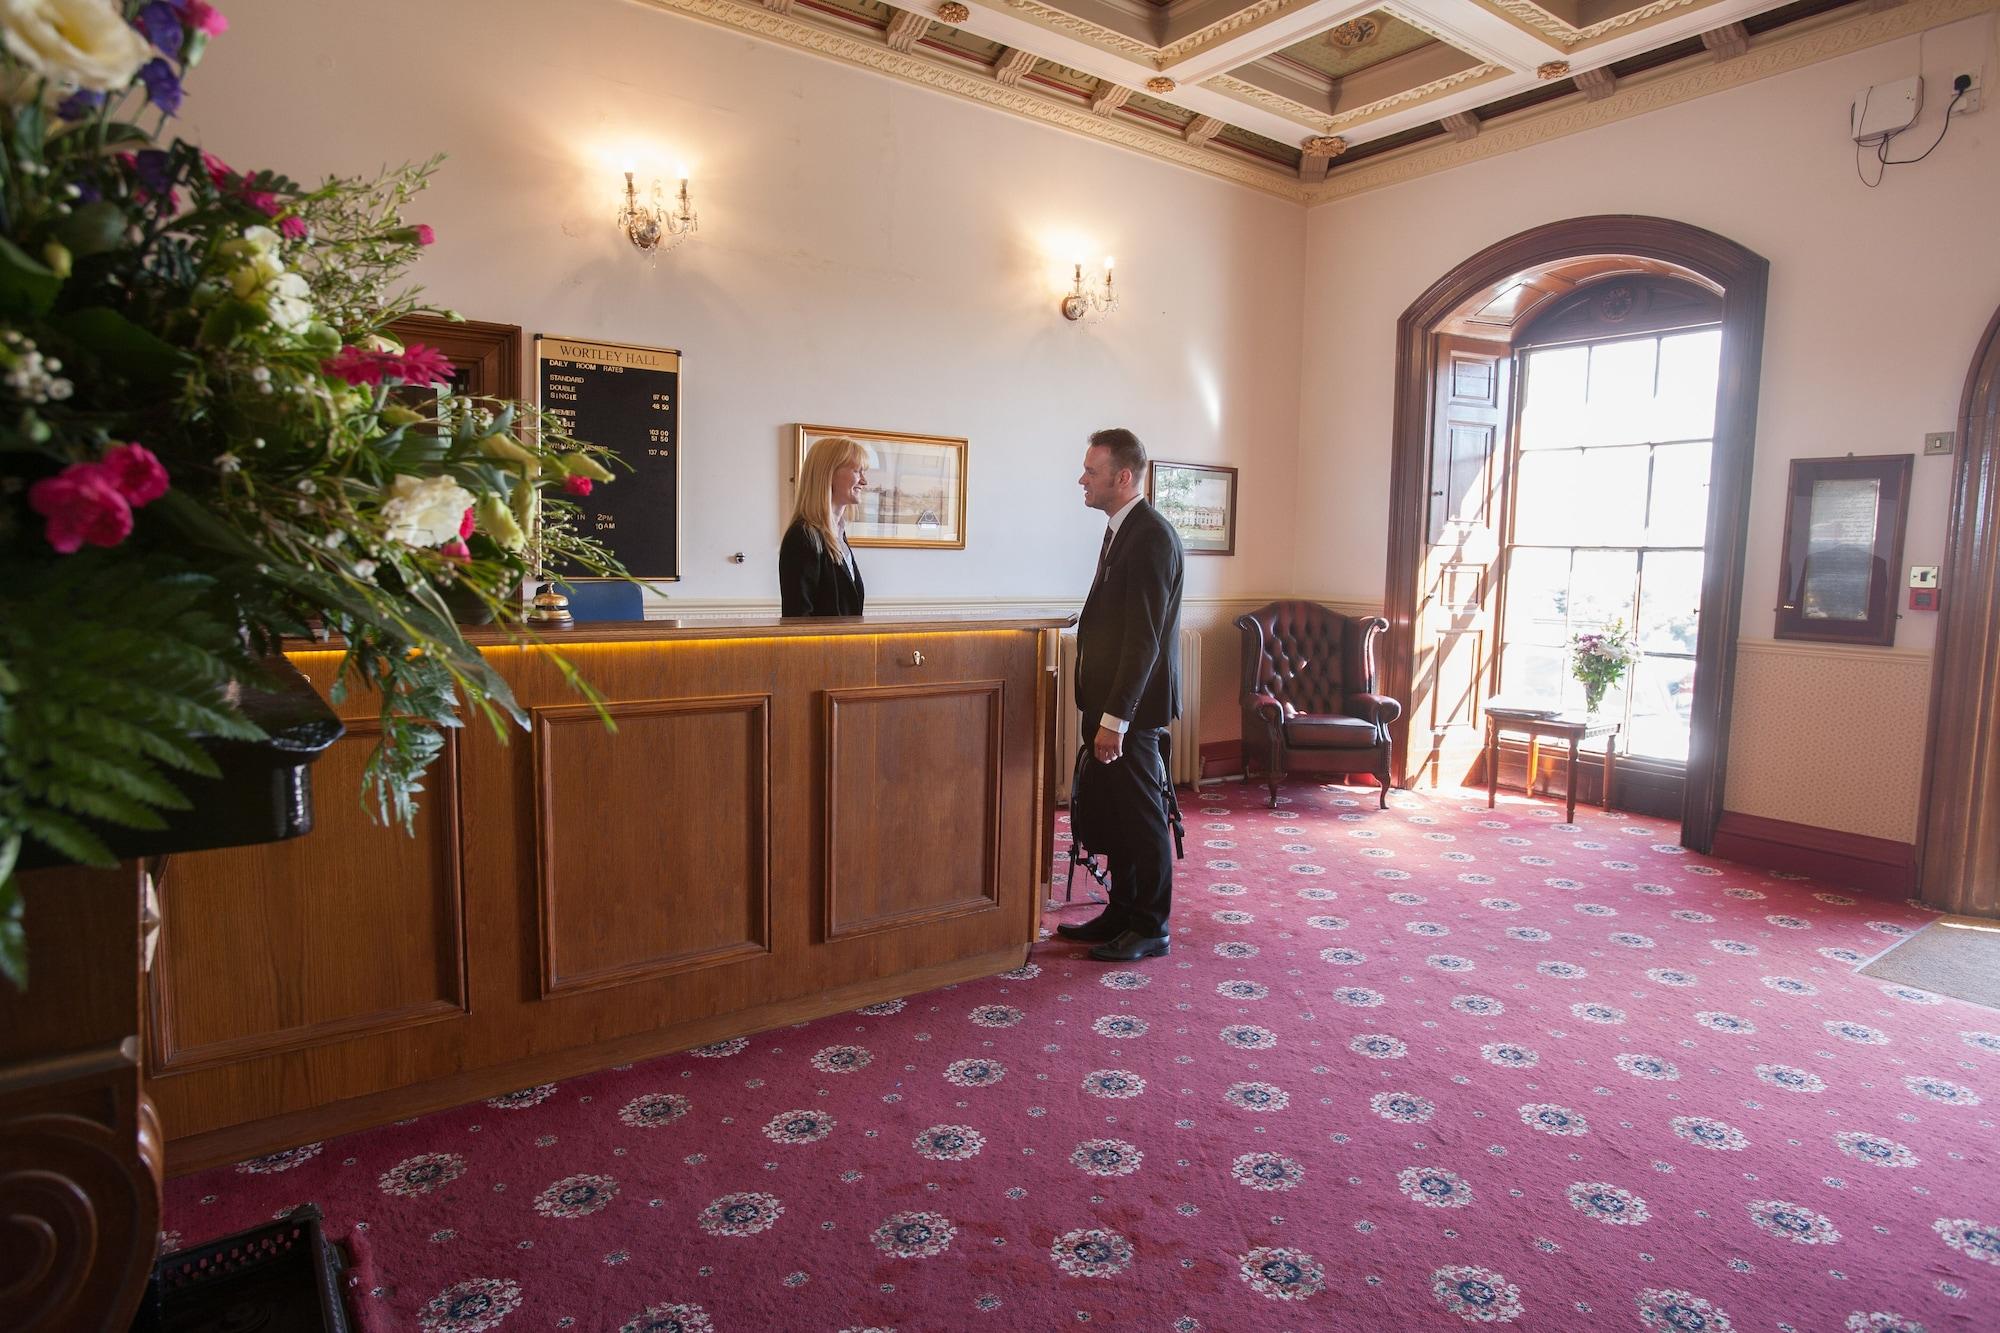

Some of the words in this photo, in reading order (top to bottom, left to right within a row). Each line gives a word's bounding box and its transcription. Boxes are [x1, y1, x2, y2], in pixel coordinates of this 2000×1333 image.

[560, 345, 623, 361] WORTLEY
[626, 353, 659, 366] HALL
[549, 360, 568, 368] DAILY
[576, 363, 596, 371] ROOM
[603, 365, 624, 373] RATES
[549, 374, 584, 383] STANDARD
[549, 384, 576, 393] DOUBLE
[550, 392, 577, 401] SINGLE
